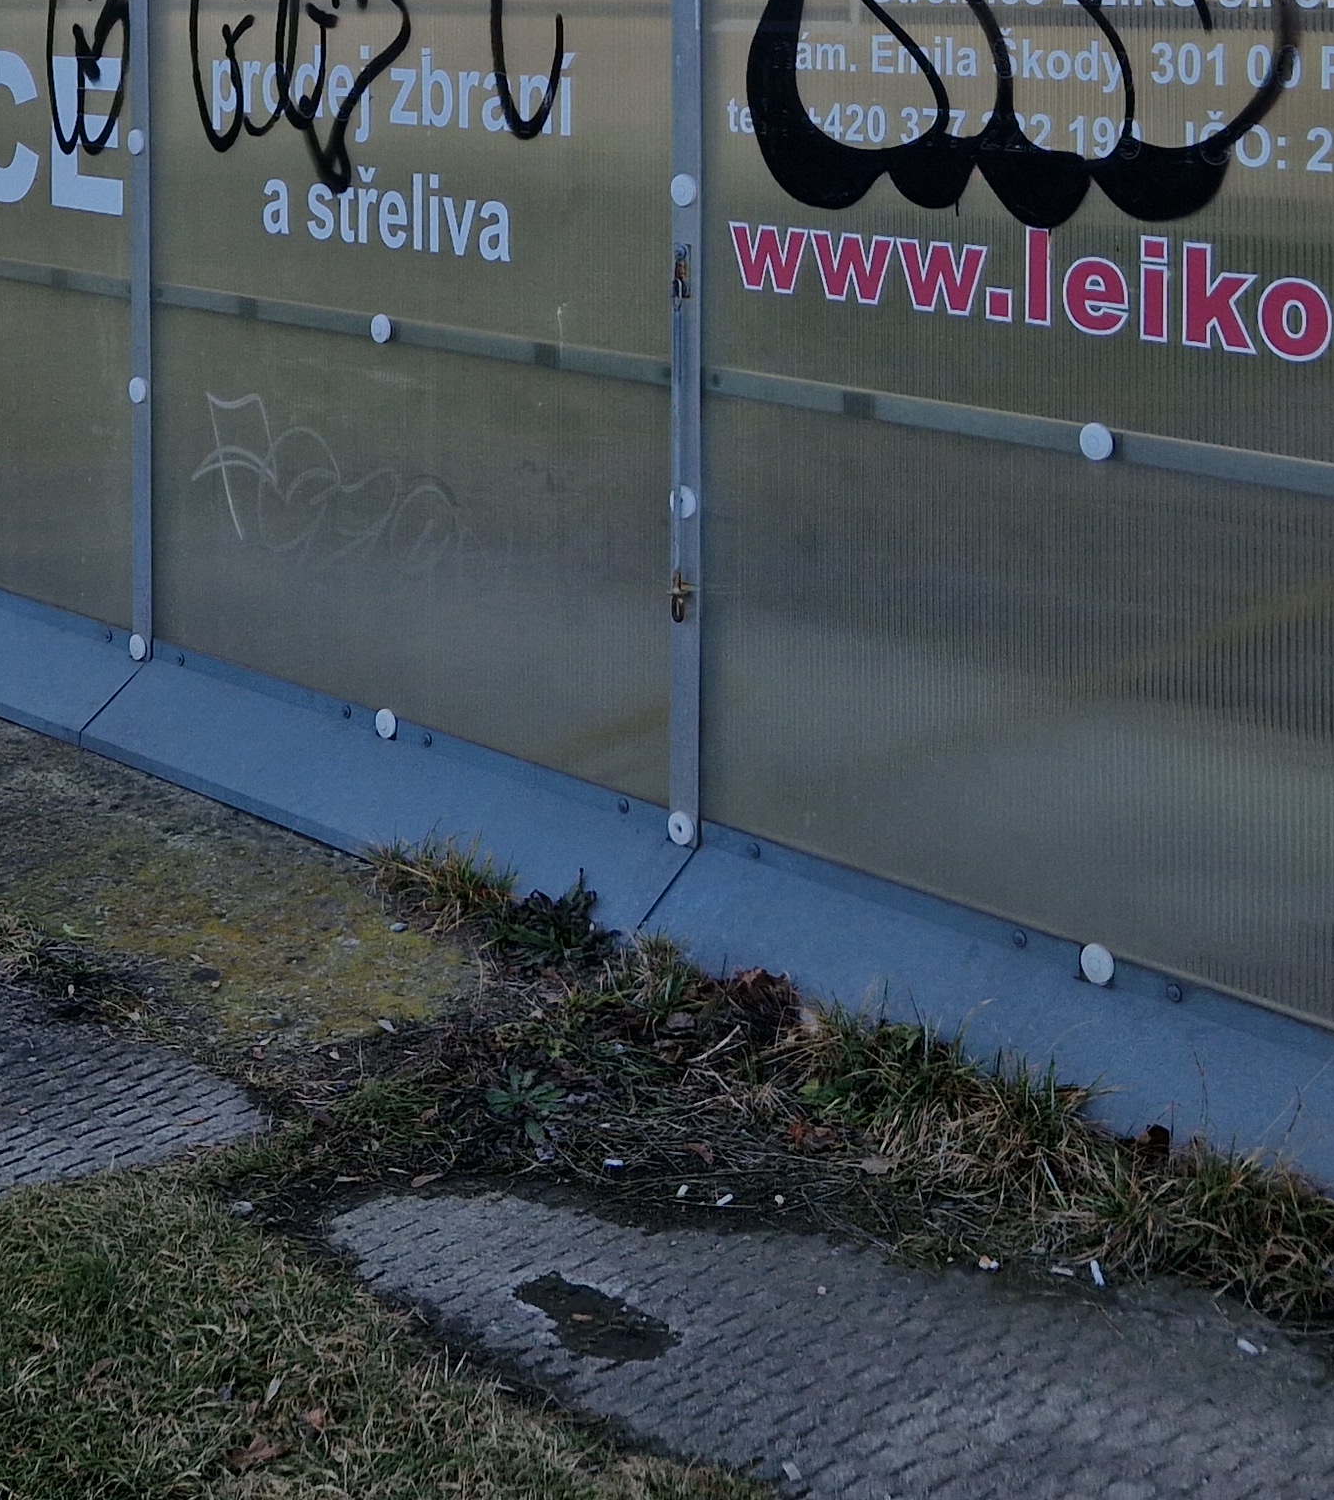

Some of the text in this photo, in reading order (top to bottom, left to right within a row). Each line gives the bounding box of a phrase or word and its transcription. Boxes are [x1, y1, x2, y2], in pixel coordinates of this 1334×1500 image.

[210, 44, 578, 143] prodej zbraní
[775, 31, 857, 73] ám.
[871, 34, 978, 78] Emila
[1150, 40, 1226, 87] 301
[262, 165, 511, 263] a střeliva
